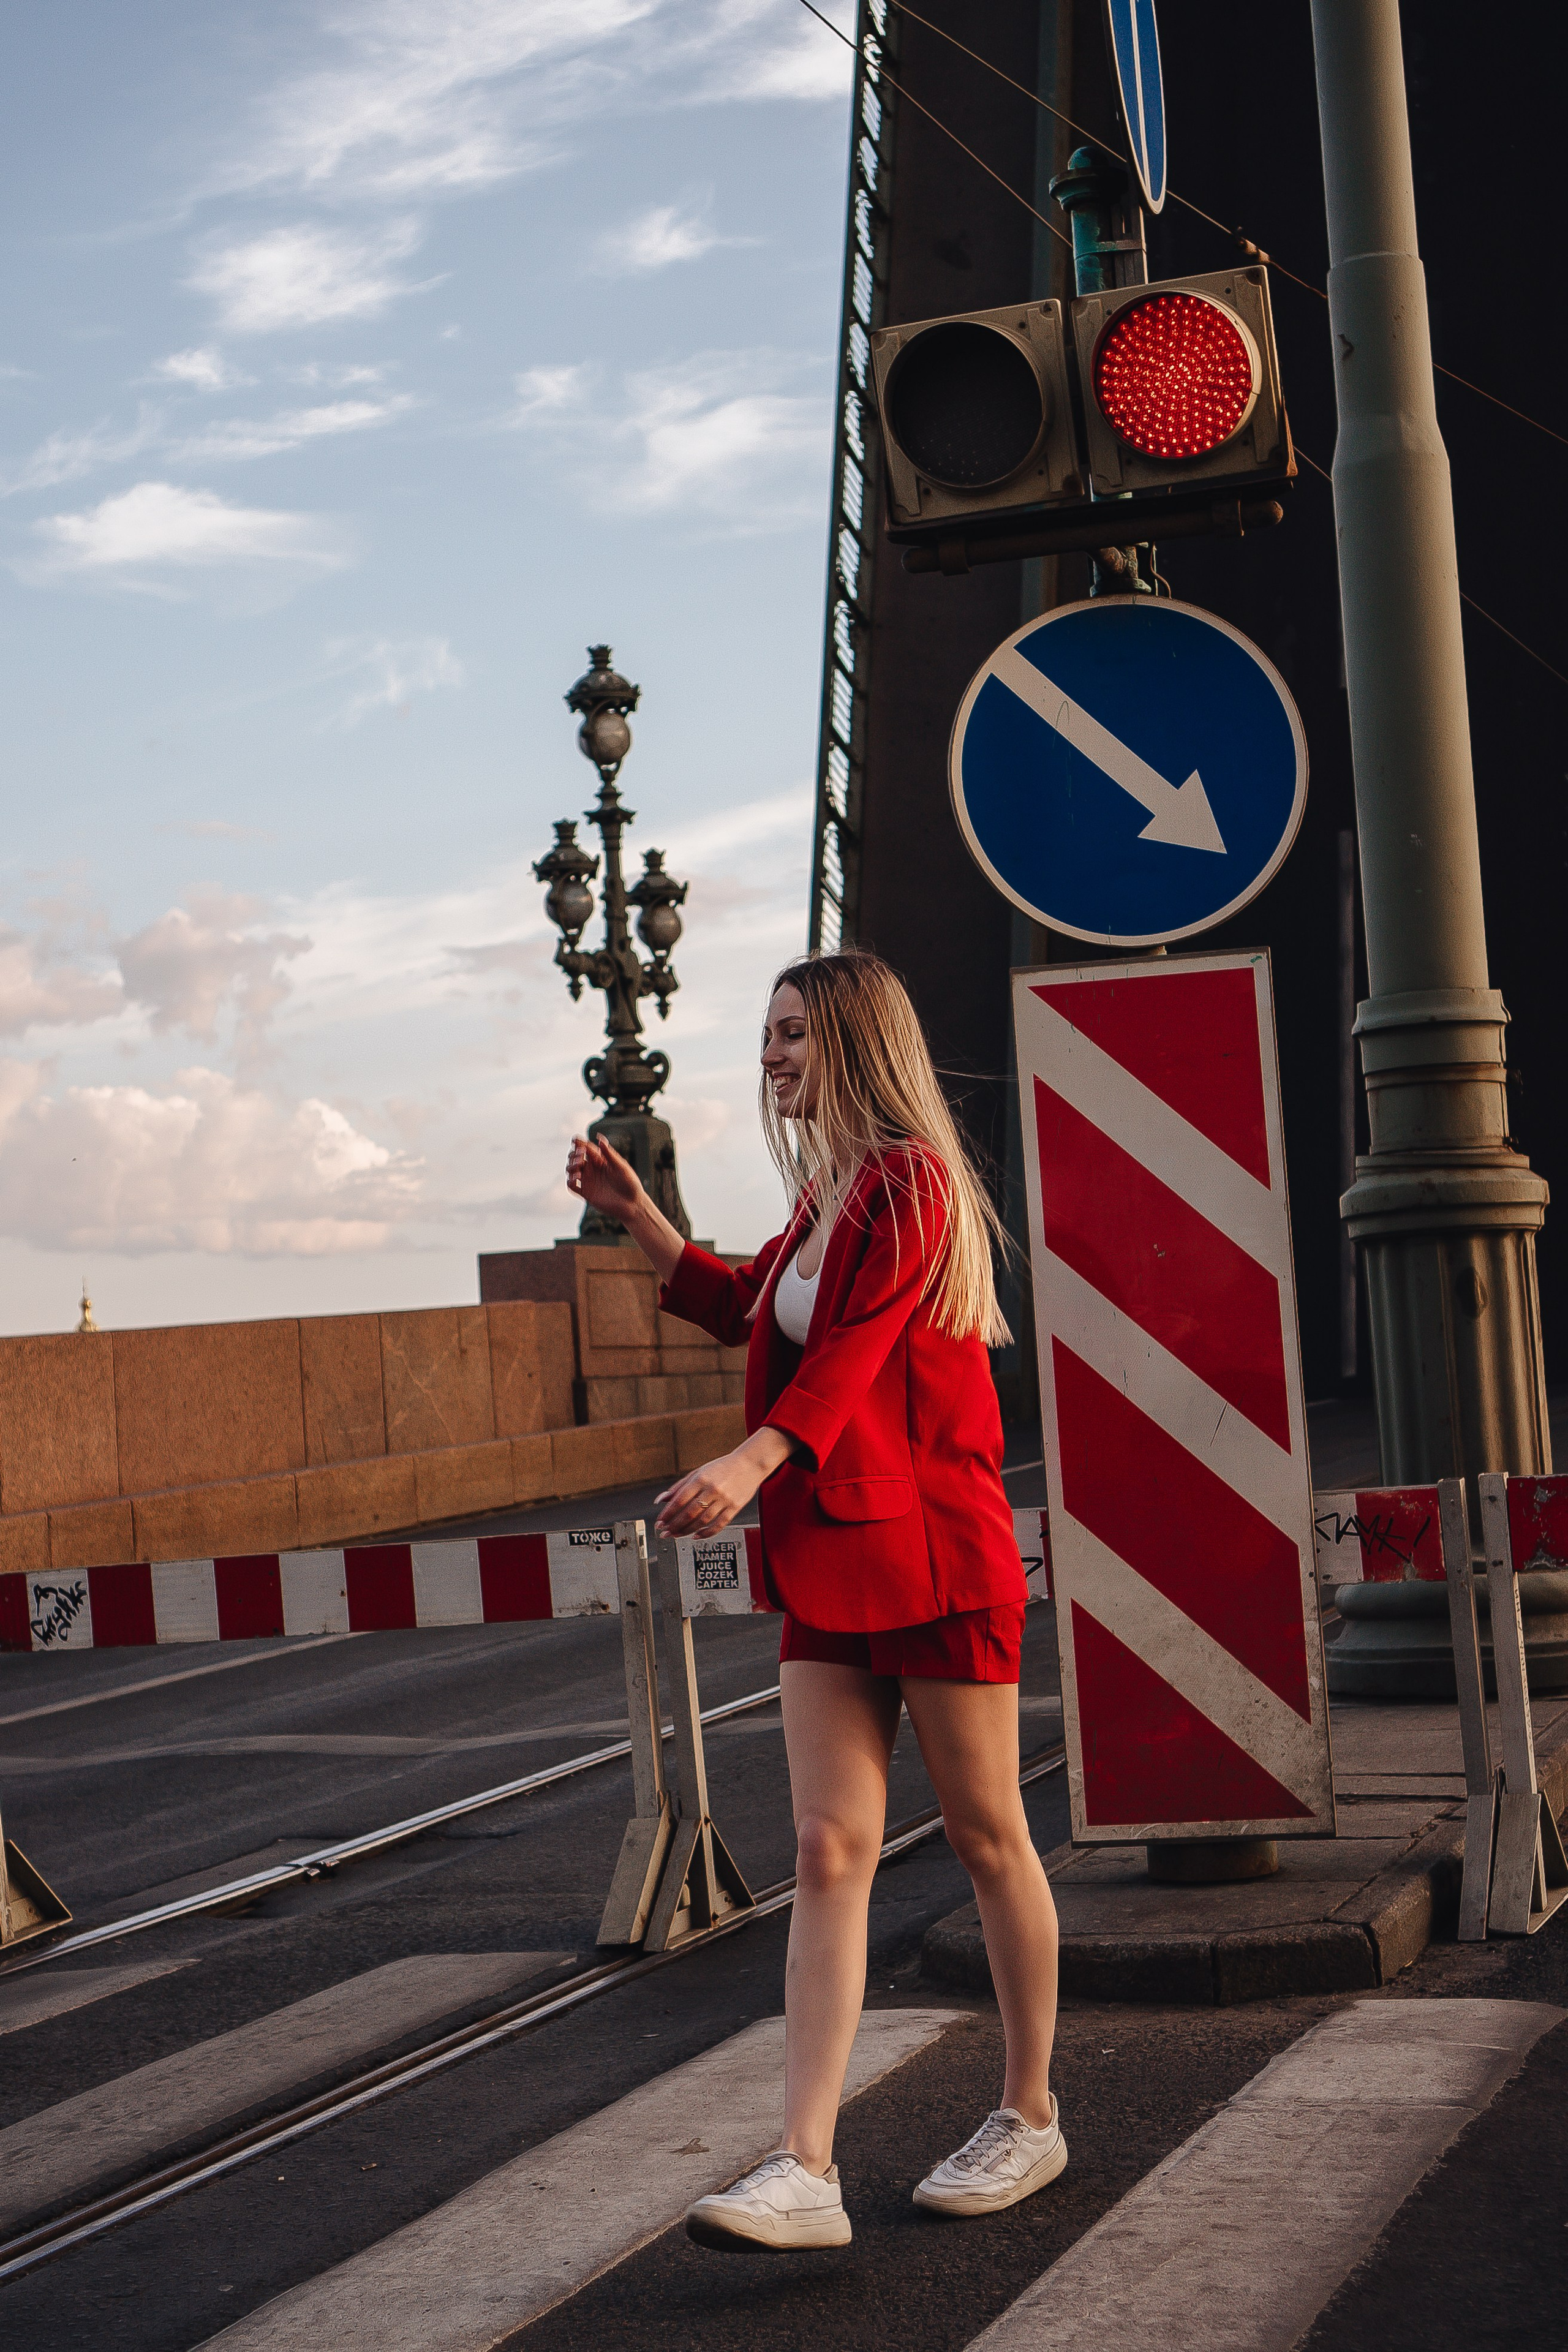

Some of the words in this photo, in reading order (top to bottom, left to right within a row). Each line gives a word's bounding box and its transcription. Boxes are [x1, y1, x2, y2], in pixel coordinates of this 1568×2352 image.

[696, 1552, 734, 1561] NAMER
[700, 1561, 731, 1570] JUICE
[698, 1570, 734, 1580] COZEK
